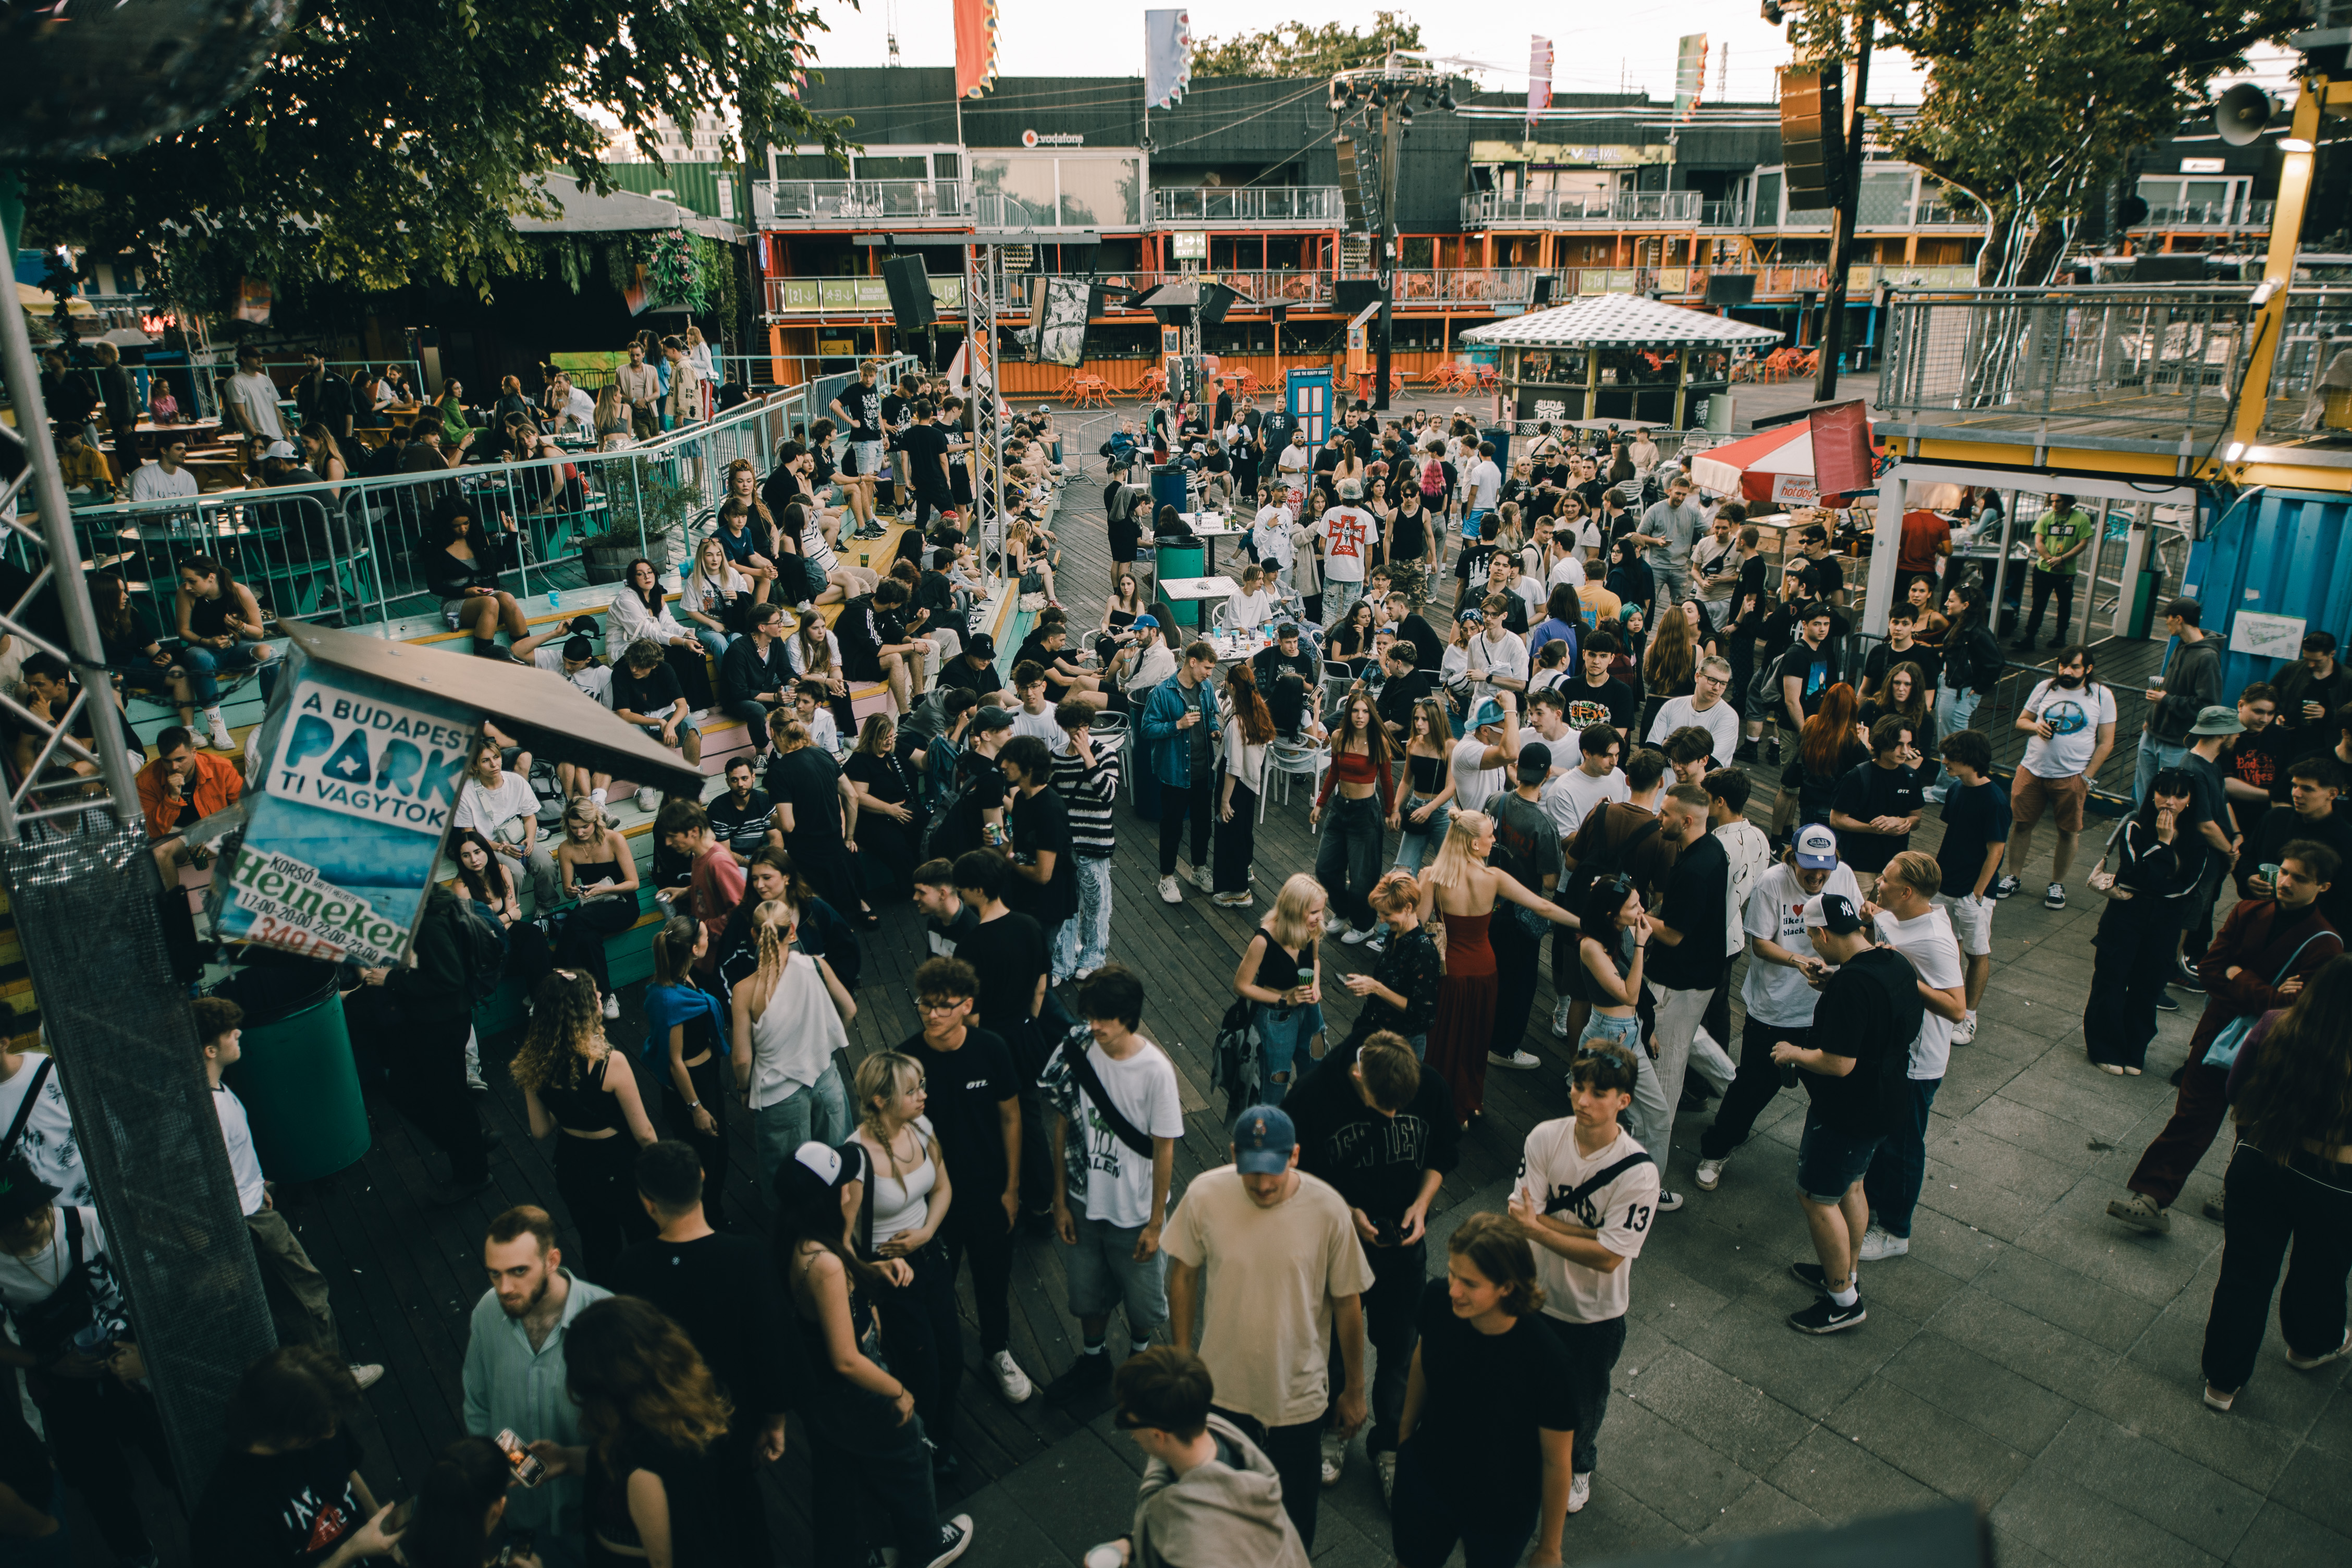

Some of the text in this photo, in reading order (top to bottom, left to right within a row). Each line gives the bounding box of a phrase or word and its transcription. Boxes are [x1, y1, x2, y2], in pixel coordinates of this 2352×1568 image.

[1039, 131, 1084, 143] vodafone
[1480, 278, 1526, 298] Wolt
[1594, 276, 1604, 288] [3]
[789, 288, 803, 304] [2]
[945, 285, 958, 300] [2]
[1538, 399, 1562, 410] BUDA
[1538, 411, 1561, 420] PEST
[1781, 486, 1813, 500] hotdog
[302, 692, 322, 713] A
[285, 714, 468, 808] PARK
[892, 756, 902, 773] PUMA
[2236, 754, 2257, 769] Bad
[2244, 769, 2273, 786] Vibes
[281, 770, 446, 829] TI VAGYTOK
[269, 856, 314, 885] KORSÓ
[1783, 904, 1787, 915] I
[1840, 901, 1854, 916] NY
[241, 892, 379, 962] 17:00-20:00 22:00-23:00
[1783, 927, 1805, 937] black
[1623, 1203, 1650, 1232] 13
